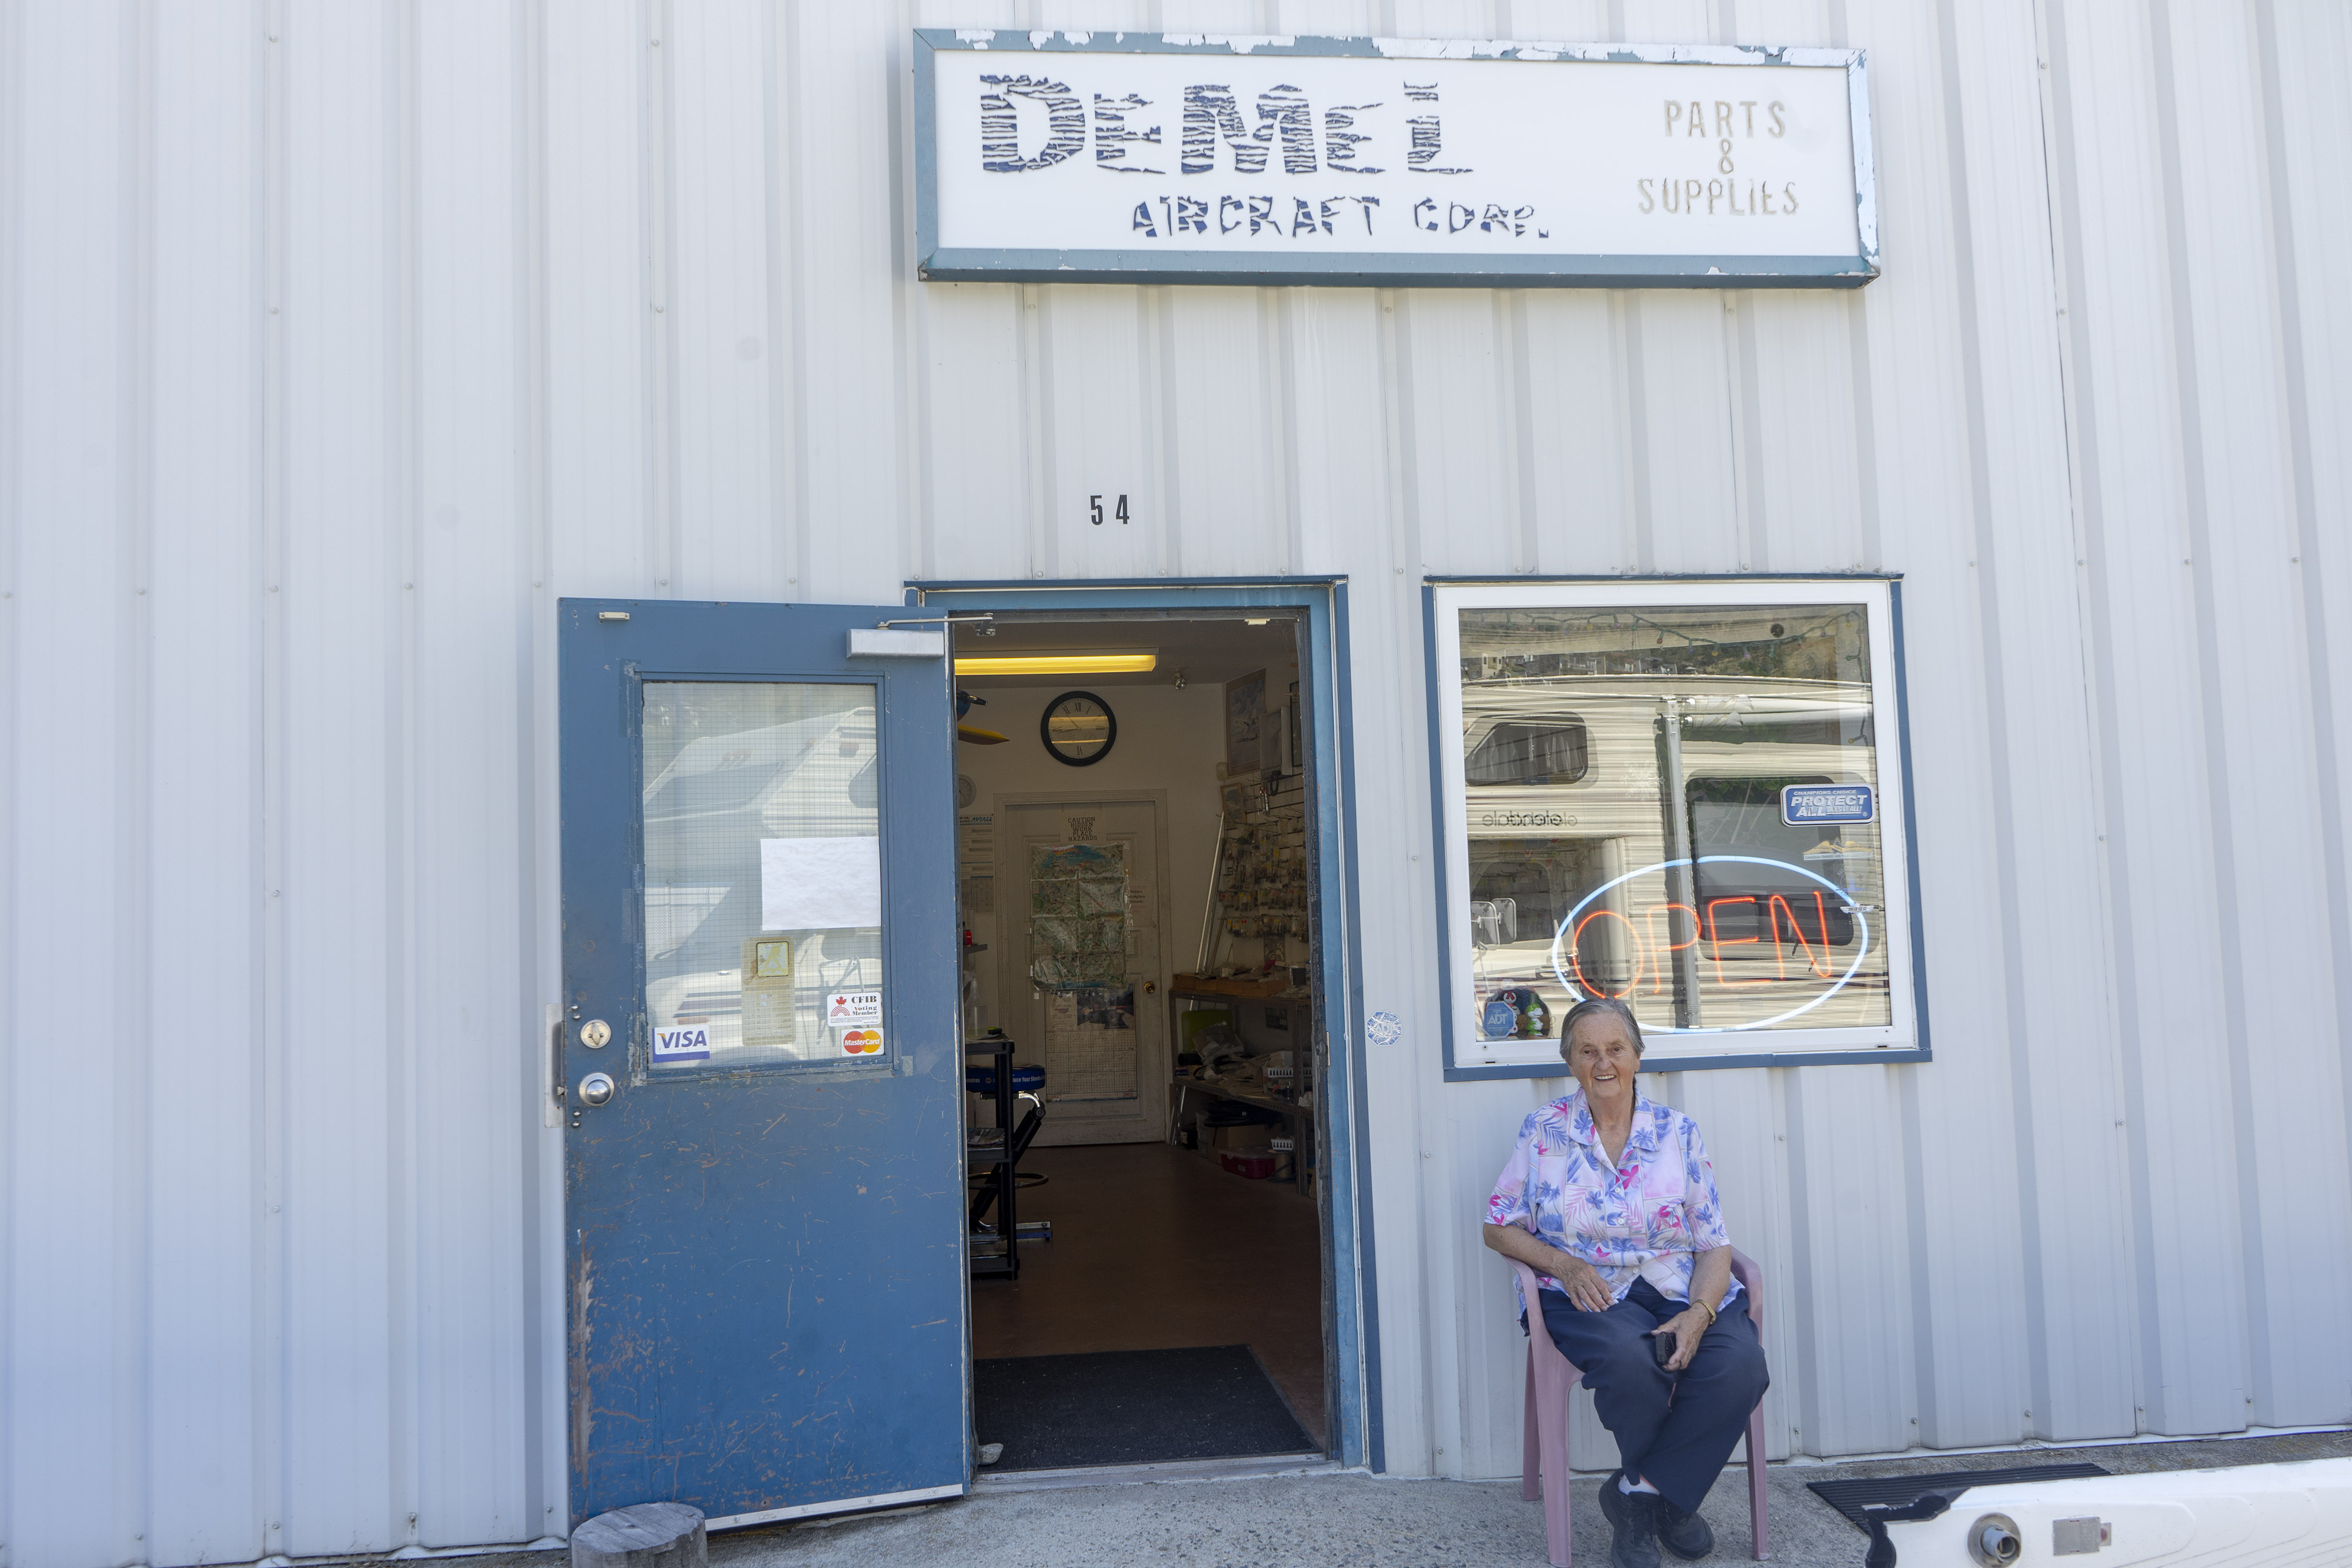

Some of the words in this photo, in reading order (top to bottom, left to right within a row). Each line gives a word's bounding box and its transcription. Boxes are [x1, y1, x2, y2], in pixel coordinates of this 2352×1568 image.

[980, 74, 1474, 175] DEMEL
[1663, 99, 1786, 140] PARTS
[1637, 177, 1799, 216] SUPPLIES
[1132, 195, 1380, 238] AIRCRAFT
[1414, 196, 1549, 239] CORP.
[1790, 795, 1868, 807] PROTECT
[1795, 807, 1826, 817] ALL
[1573, 891, 1832, 998] OPEN
[851, 995, 877, 1004] CFIB
[1488, 1014, 1508, 1025] ADT
[657, 1029, 708, 1048] VISA
